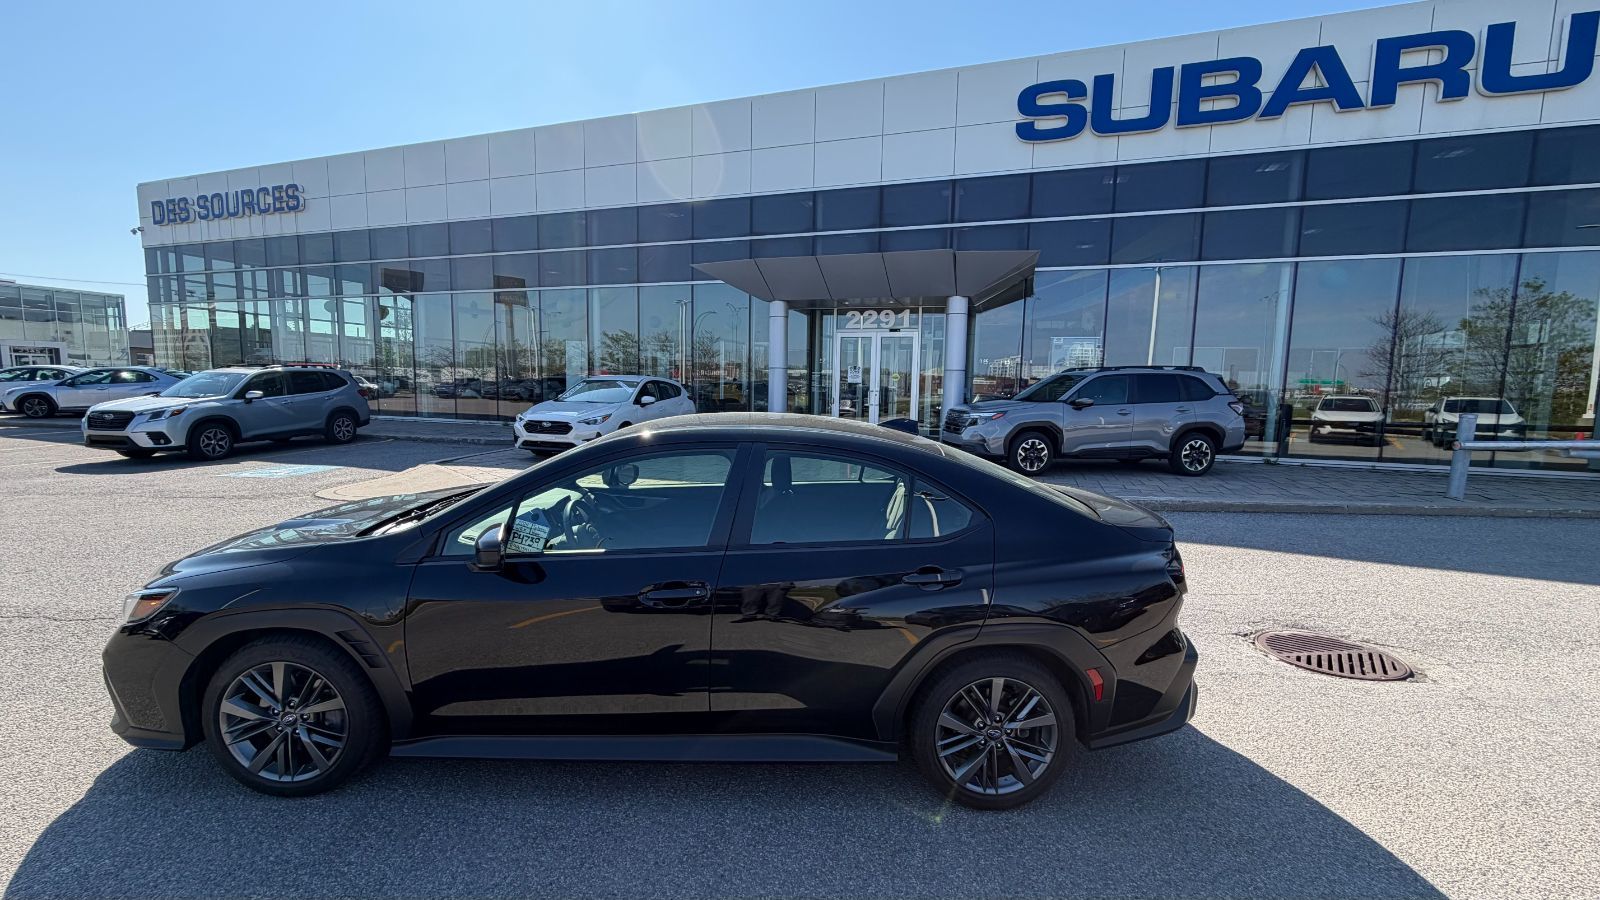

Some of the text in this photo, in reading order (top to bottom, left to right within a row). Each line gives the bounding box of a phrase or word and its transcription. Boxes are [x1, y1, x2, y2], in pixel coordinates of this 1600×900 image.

[1015, 11, 1600, 143] SUBARU
[151, 183, 302, 226] DES SOURCES
[845, 309, 910, 329] 2291
